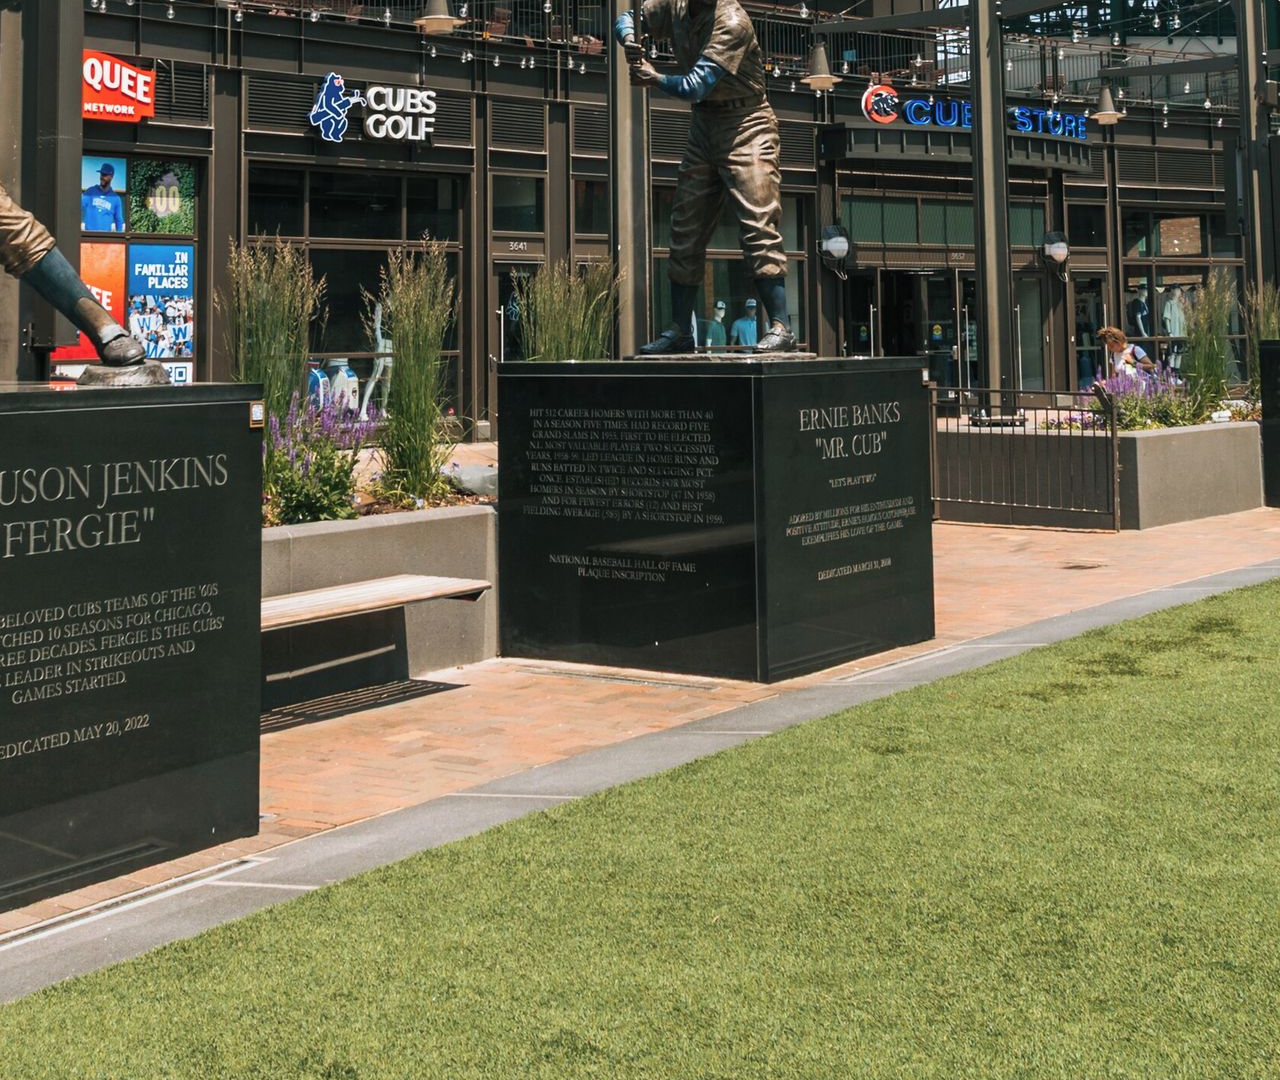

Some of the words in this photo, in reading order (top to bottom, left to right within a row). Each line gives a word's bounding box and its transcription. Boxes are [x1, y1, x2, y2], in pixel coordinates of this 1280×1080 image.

[84, 103, 135, 114] NETWORK
[367, 87, 437, 114] CUBS
[366, 114, 436, 140] GOLF
[1015, 106, 1088, 140] STORE
[175, 252, 188, 263] IN
[509, 242, 527, 251] 3641
[135, 264, 188, 276] FAMILIAR
[148, 277, 188, 288] PLACES
[173, 326, 187, 340] W
[800, 409, 848, 431] ERNIE
[852, 402, 900, 426] BANKS
[816, 437, 848, 459] "MR.
[852, 431, 886, 455] CUB"
[97, 454, 227, 508] JENKINS
[549, 555, 591, 565] NATIONAL
[592, 557, 632, 567] BASEBALL
[634, 560, 657, 569] HALL
[659, 562, 669, 570] OF
[672, 562, 696, 572] FAME
[578, 568, 610, 578] PLAQUE
[612, 570, 665, 582] INSCRIPTION
[818, 565, 852, 580] DEDICATED
[852, 560, 873, 572] MARCH
[68, 601, 101, 618] CUBS
[105, 594, 148, 612] TEAMS
[151, 591, 168, 605] OF
[171, 587, 196, 602] THE
[199, 583, 218, 597] '60S
[48, 628, 61, 641] 10
[64, 616, 123, 638] SEASONS
[126, 612, 151, 628] FOR
[155, 602, 212, 622] CHICAGO,
[30, 639, 97, 662] DECADES.
[101, 629, 148, 649] FERGIE
[152, 627, 161, 641] IS
[164, 622, 190, 638] THE
[193, 616, 225, 633] CUBS'
[5, 664, 62, 686] LEADER
[67, 660, 81, 676] IN
[85, 645, 165, 672] STRIKEOUTS
[167, 640, 195, 656] AND
[12, 682, 62, 704] GAMES
[65, 671, 127, 694] STARTED.
[73, 724, 103, 743] MAY
[106, 720, 121, 736] 20,
[125, 715, 150, 731] 2022
